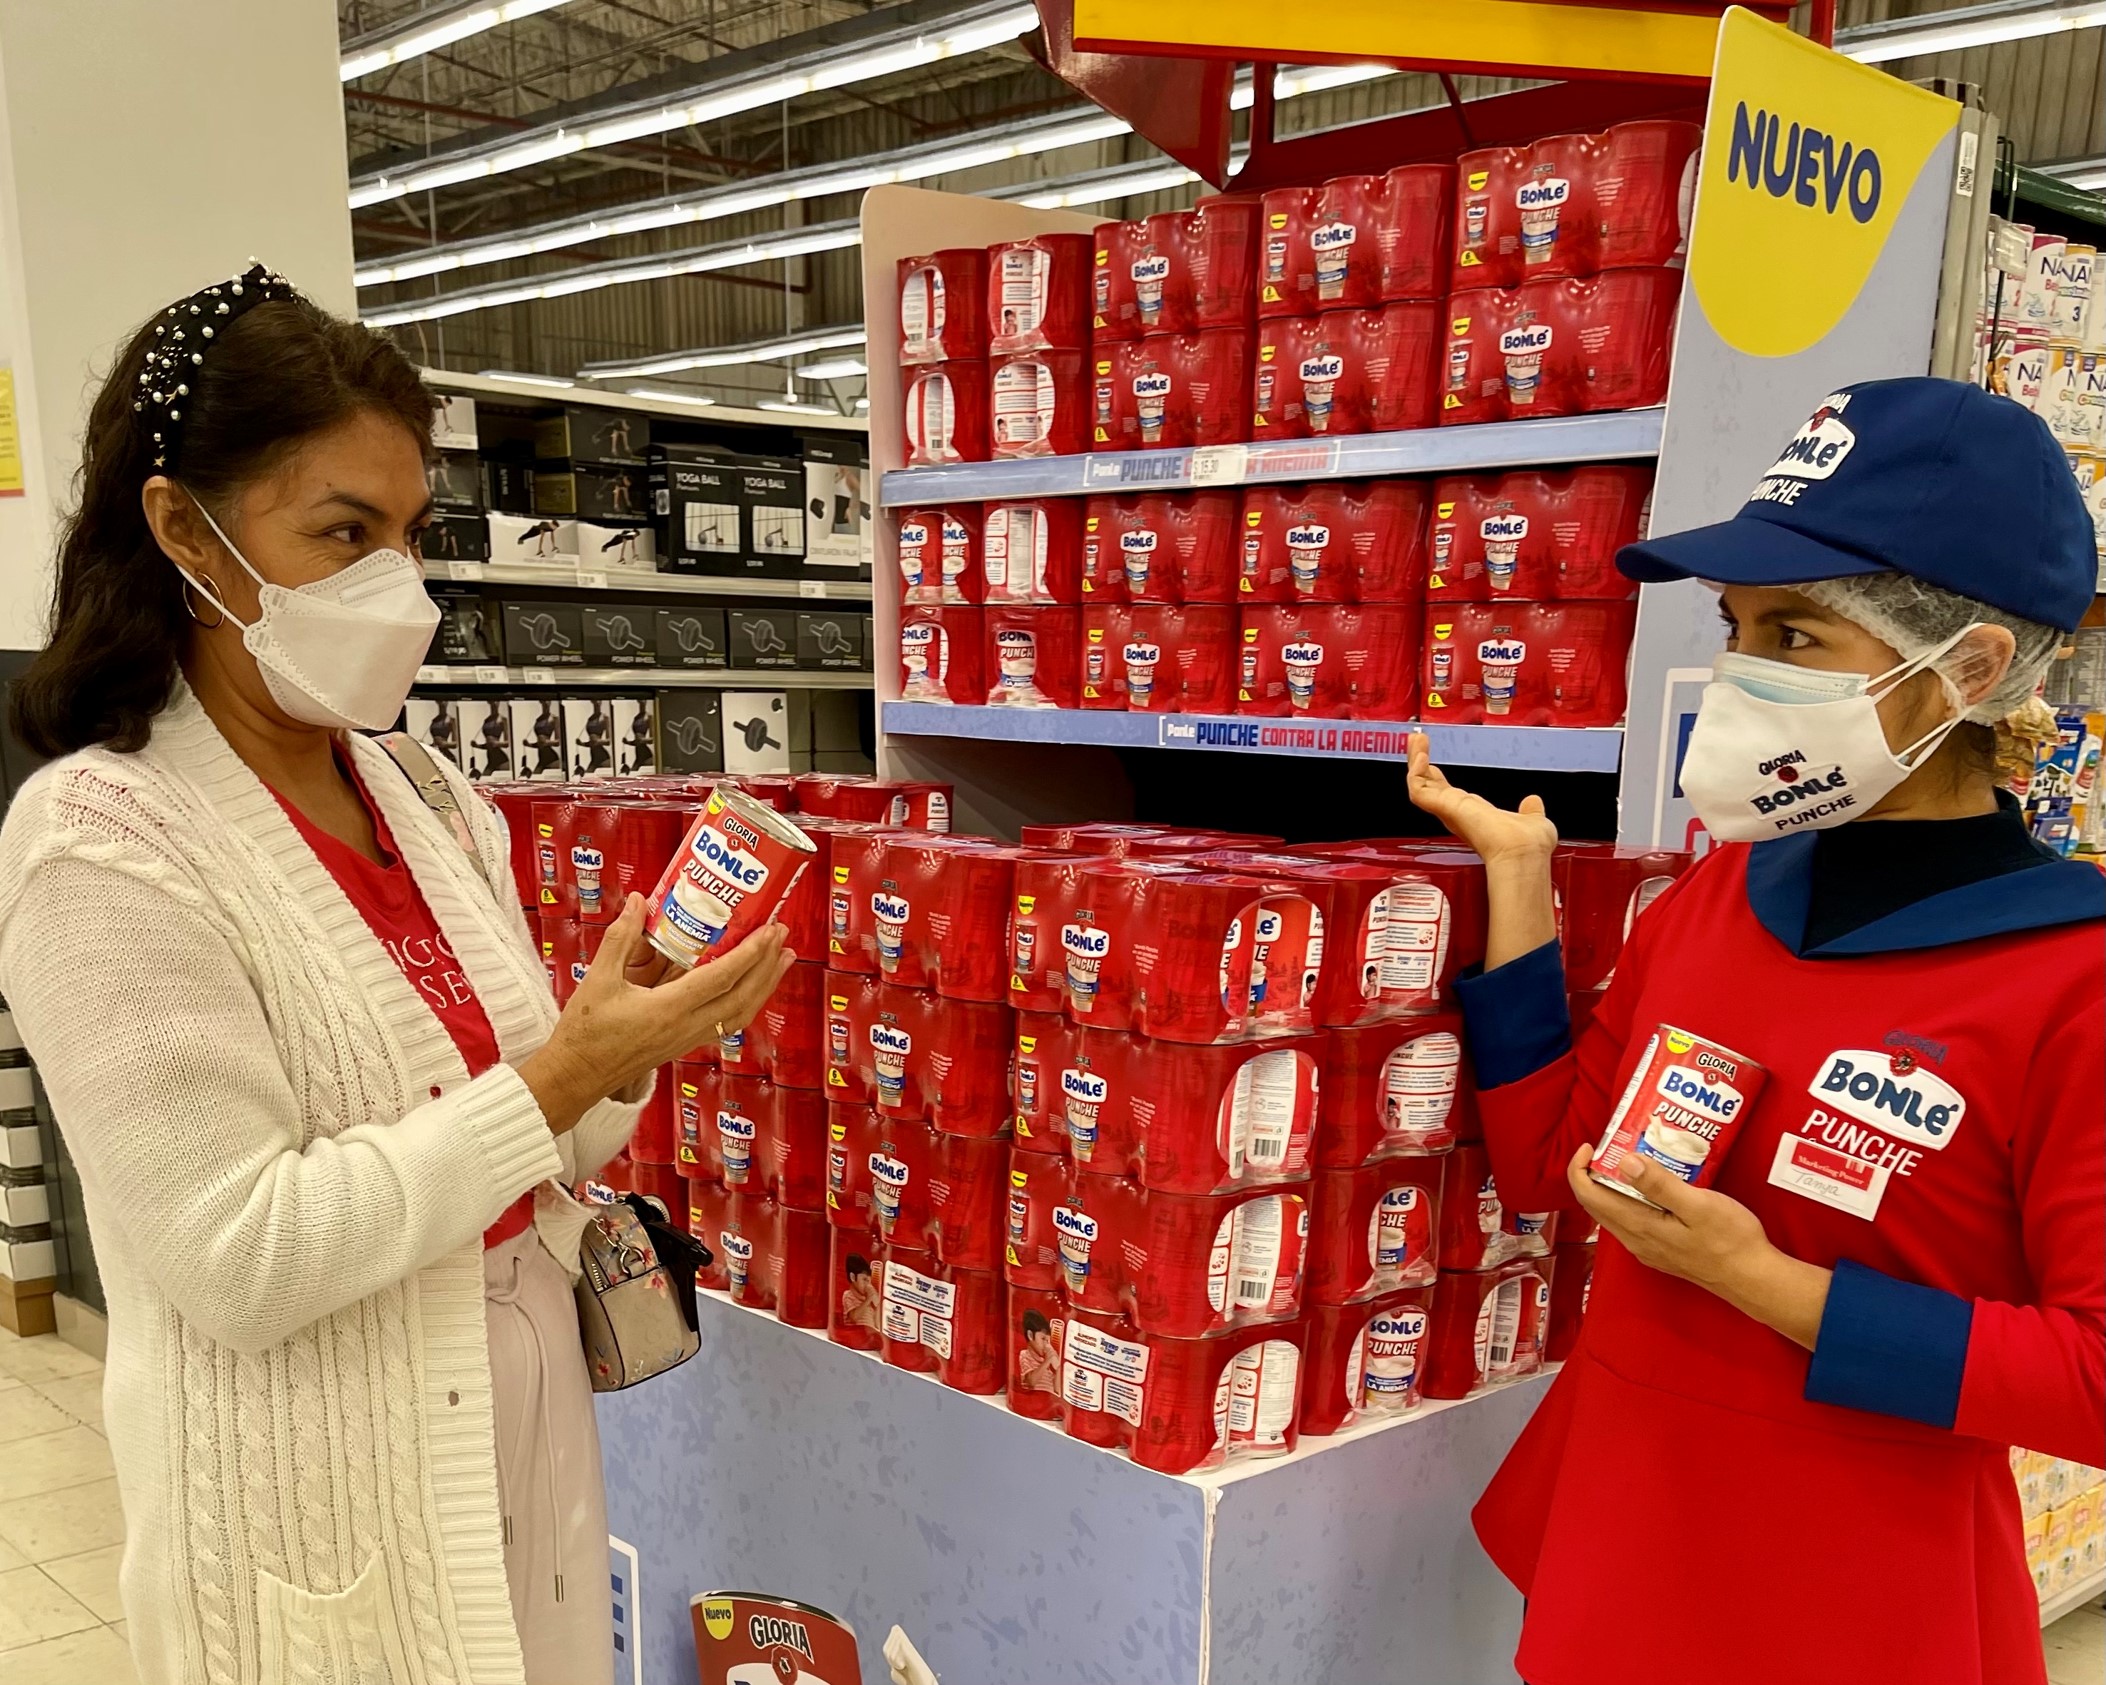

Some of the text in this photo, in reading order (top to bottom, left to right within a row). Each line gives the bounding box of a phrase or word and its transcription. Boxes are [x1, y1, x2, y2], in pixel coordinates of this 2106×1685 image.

[1728, 101, 1881, 224] NUEVO
[2072, 306, 2081, 322] 3
[676, 472, 721, 486] YOGA BALL
[744, 477, 786, 490] YOGA BALL
[1121, 456, 1182, 482] PUNCHE
[1167, 722, 1409, 754] Ponle PUNCHE CONTRA LA ANEMIA
[1758, 750, 1807, 776] GLORIA
[1775, 794, 1857, 830] PUNCHE
[724, 817, 759, 850] GLORIA
[682, 859, 744, 907] PUNCHE
[665, 905, 712, 942] LA ANEMIA
[1670, 1036, 1690, 1049] Nuevo
[1883, 1030, 1948, 1067] GLORIA
[1698, 1052, 1736, 1080] GLORIA
[1653, 1101, 1723, 1142] PUNCHE
[1801, 1109, 1924, 1177] PUNCHE
[1793, 1168, 1842, 1197] Tanya
[1798, 1155, 1839, 1179] Marketing
[1839, 1170, 1865, 1186] Power
[1367, 1382, 1409, 1393] LA ANEMIA
[705, 1607, 732, 1621] Nuevo
[750, 1615, 815, 1664] GLORIA
